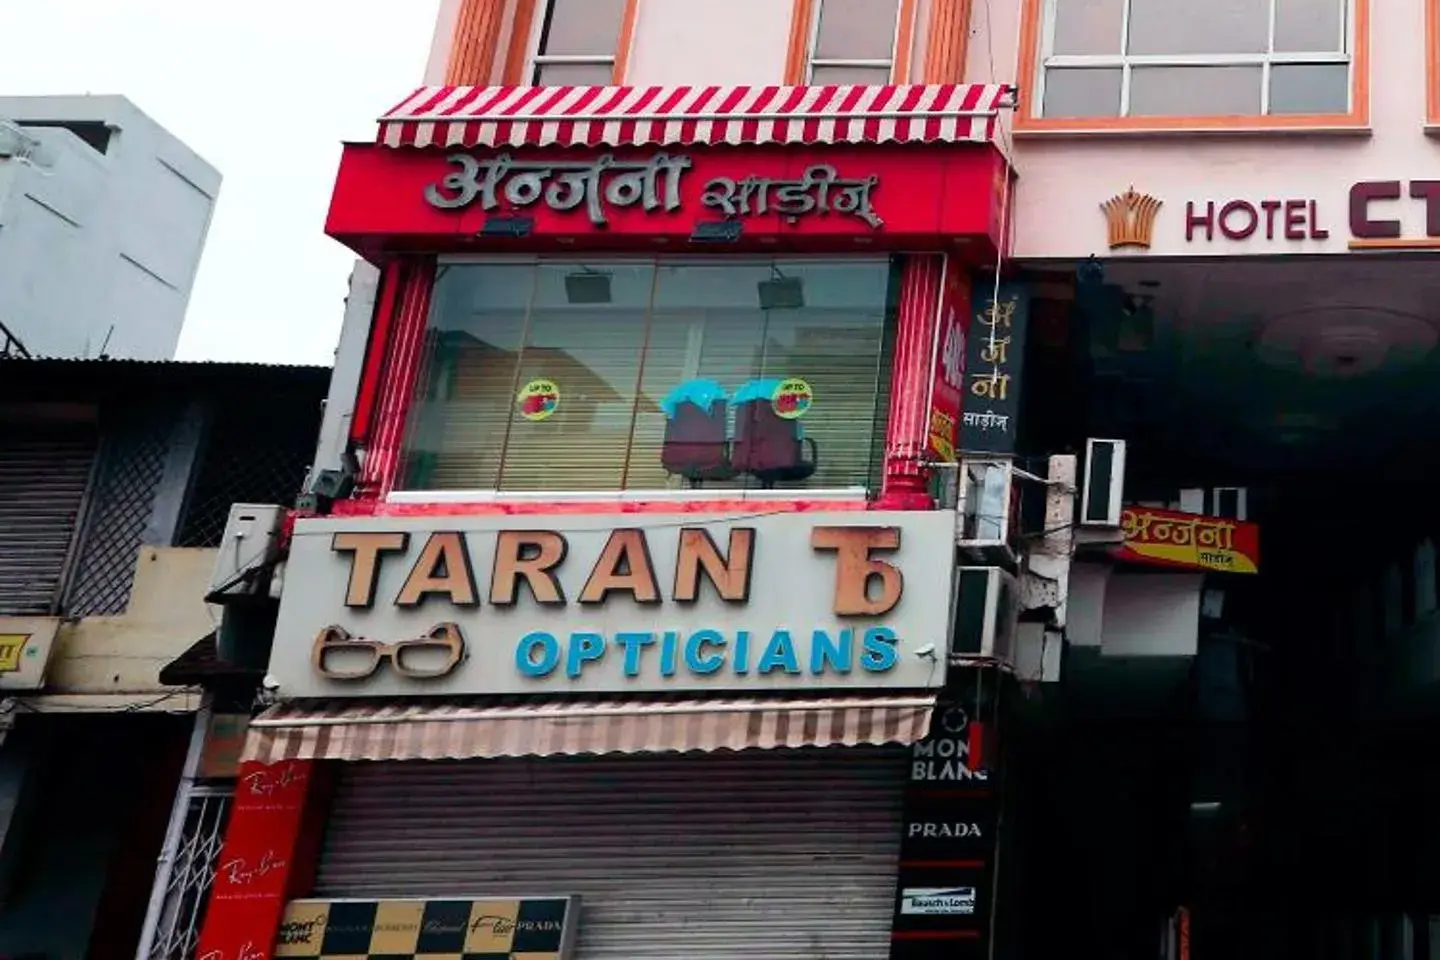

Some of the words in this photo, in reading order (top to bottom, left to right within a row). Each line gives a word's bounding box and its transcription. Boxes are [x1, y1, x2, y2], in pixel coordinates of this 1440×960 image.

[1185, 199, 1329, 241] HOTEL
[331, 525, 758, 609] TARAN
[513, 625, 901, 679] OPTICIANS
[912, 738, 971, 758] MON
[908, 822, 983, 838] PRADA
